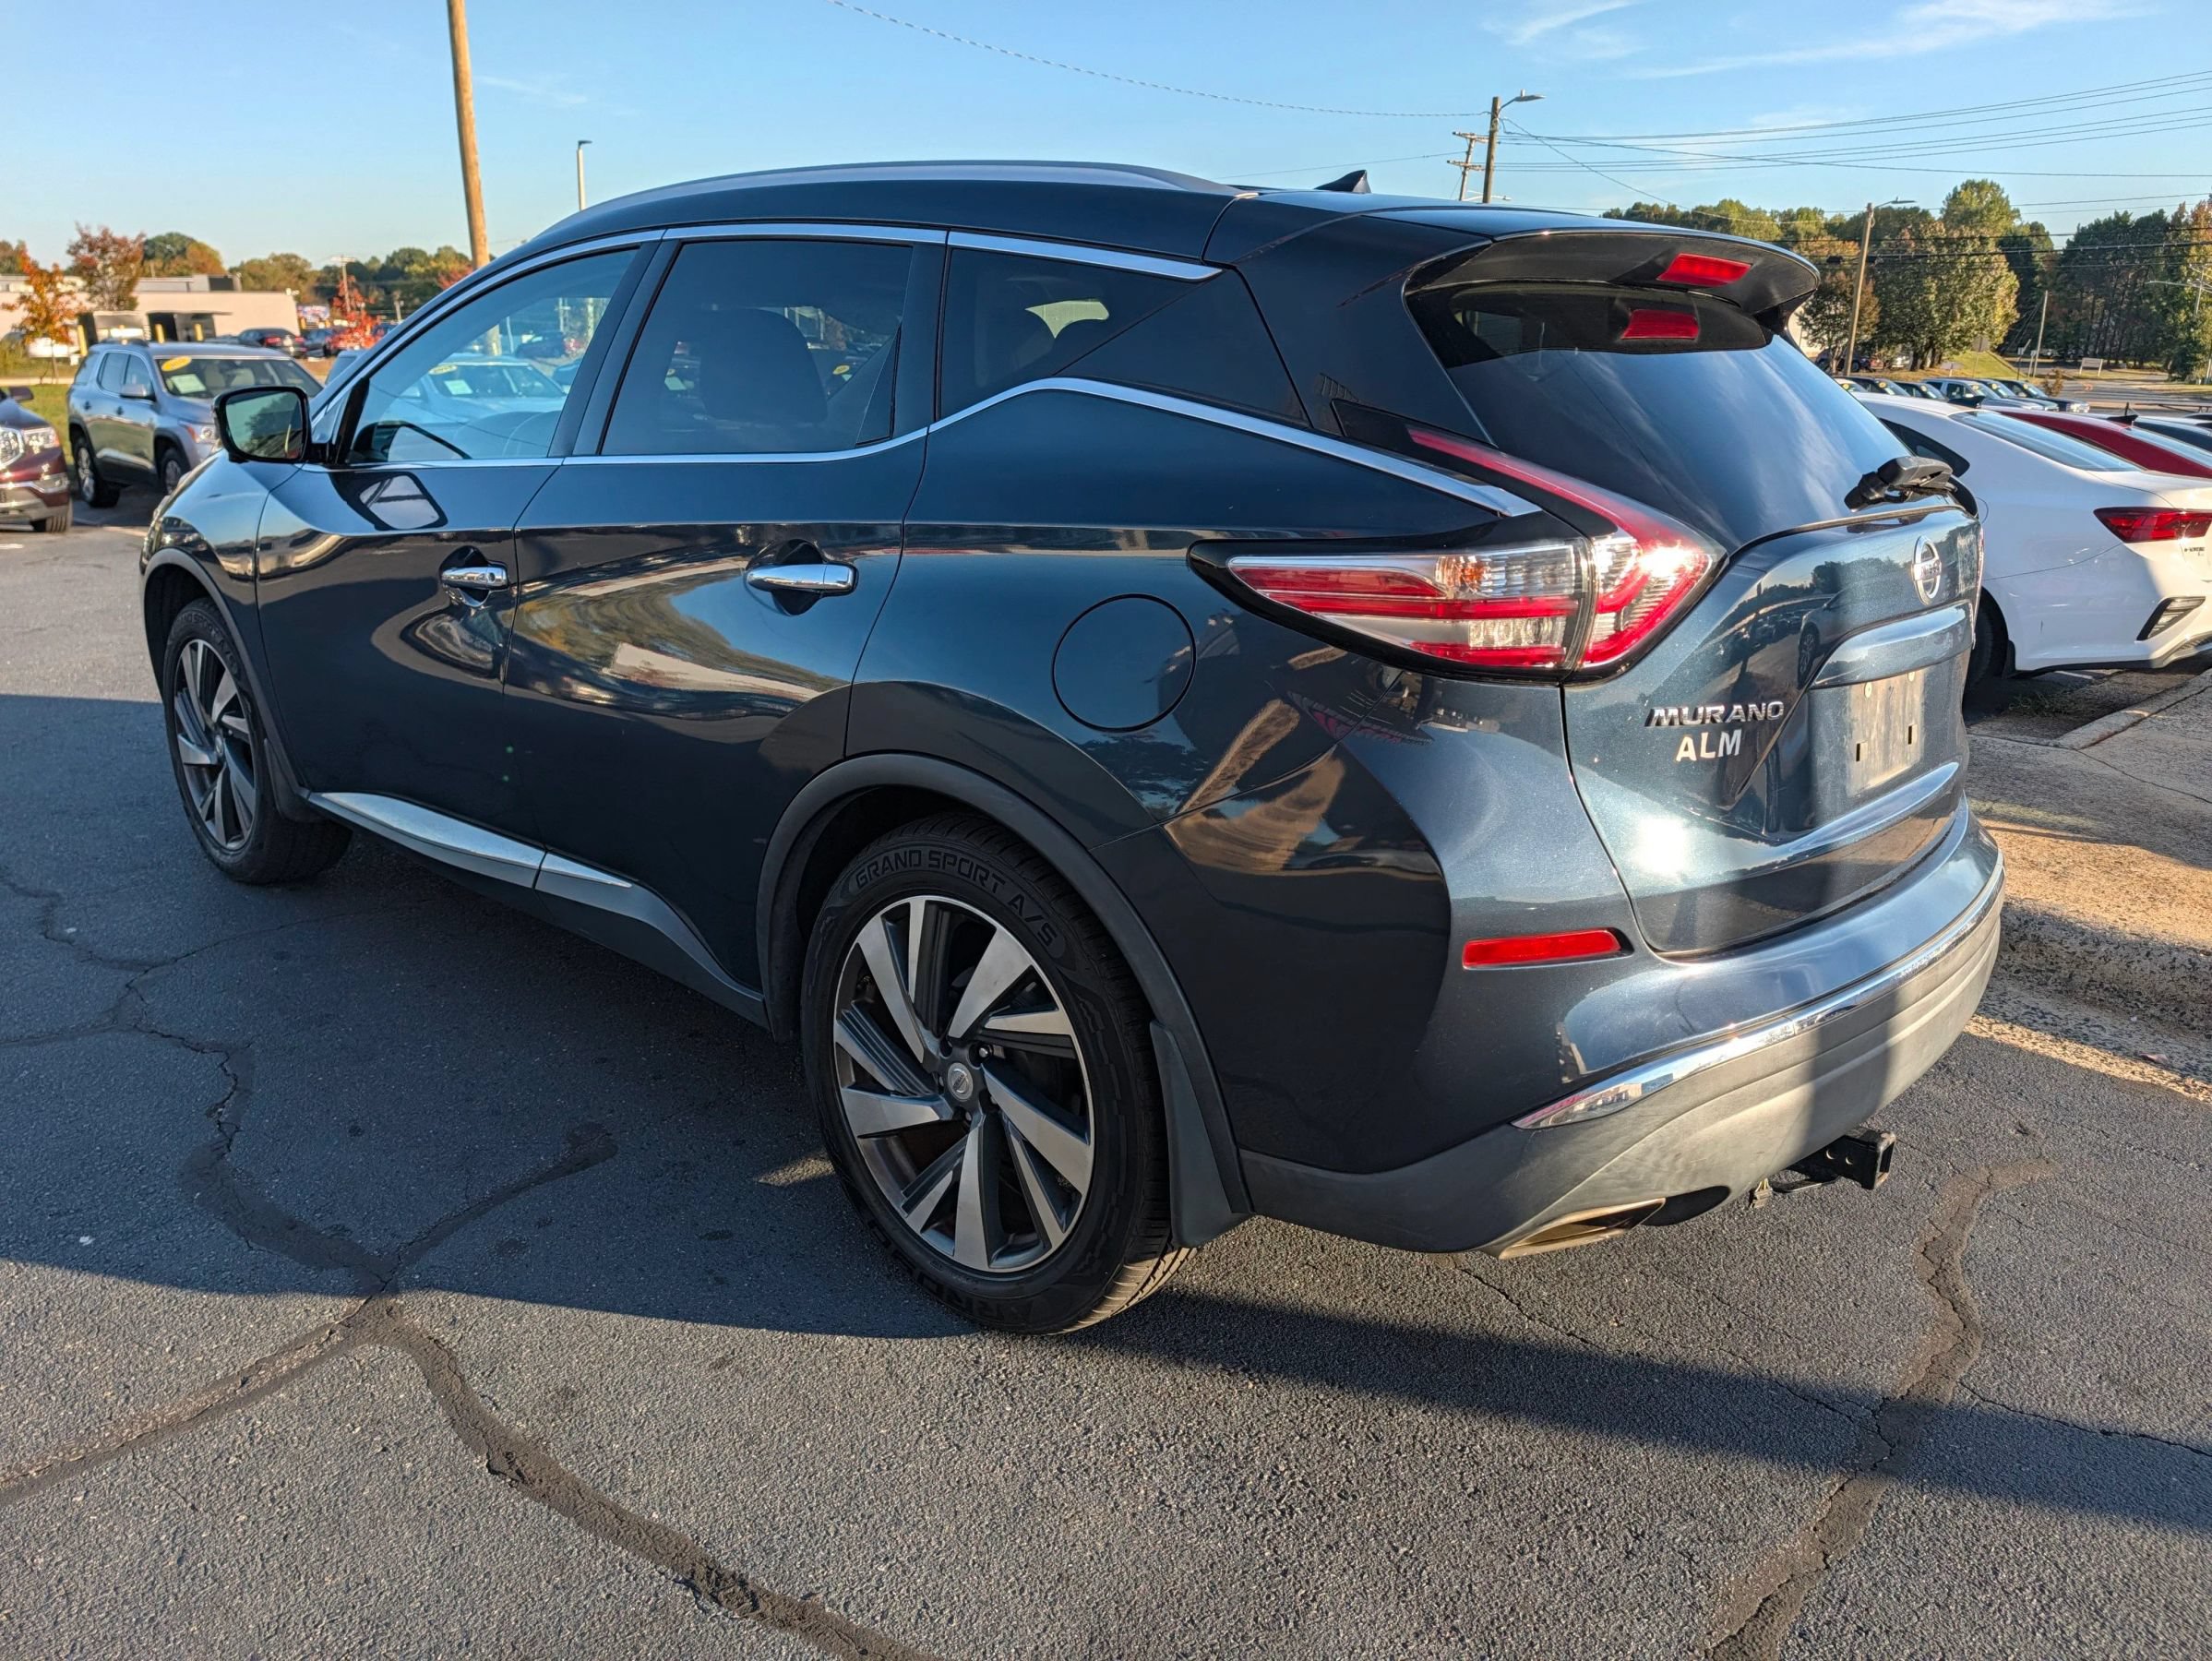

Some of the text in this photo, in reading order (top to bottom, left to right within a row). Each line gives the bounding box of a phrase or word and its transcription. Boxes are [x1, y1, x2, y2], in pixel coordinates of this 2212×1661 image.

[1644, 700, 1784, 727] MURANO
[1676, 728, 1742, 762] ALM
[855, 849, 1058, 946] GRAND SPORT A/S
